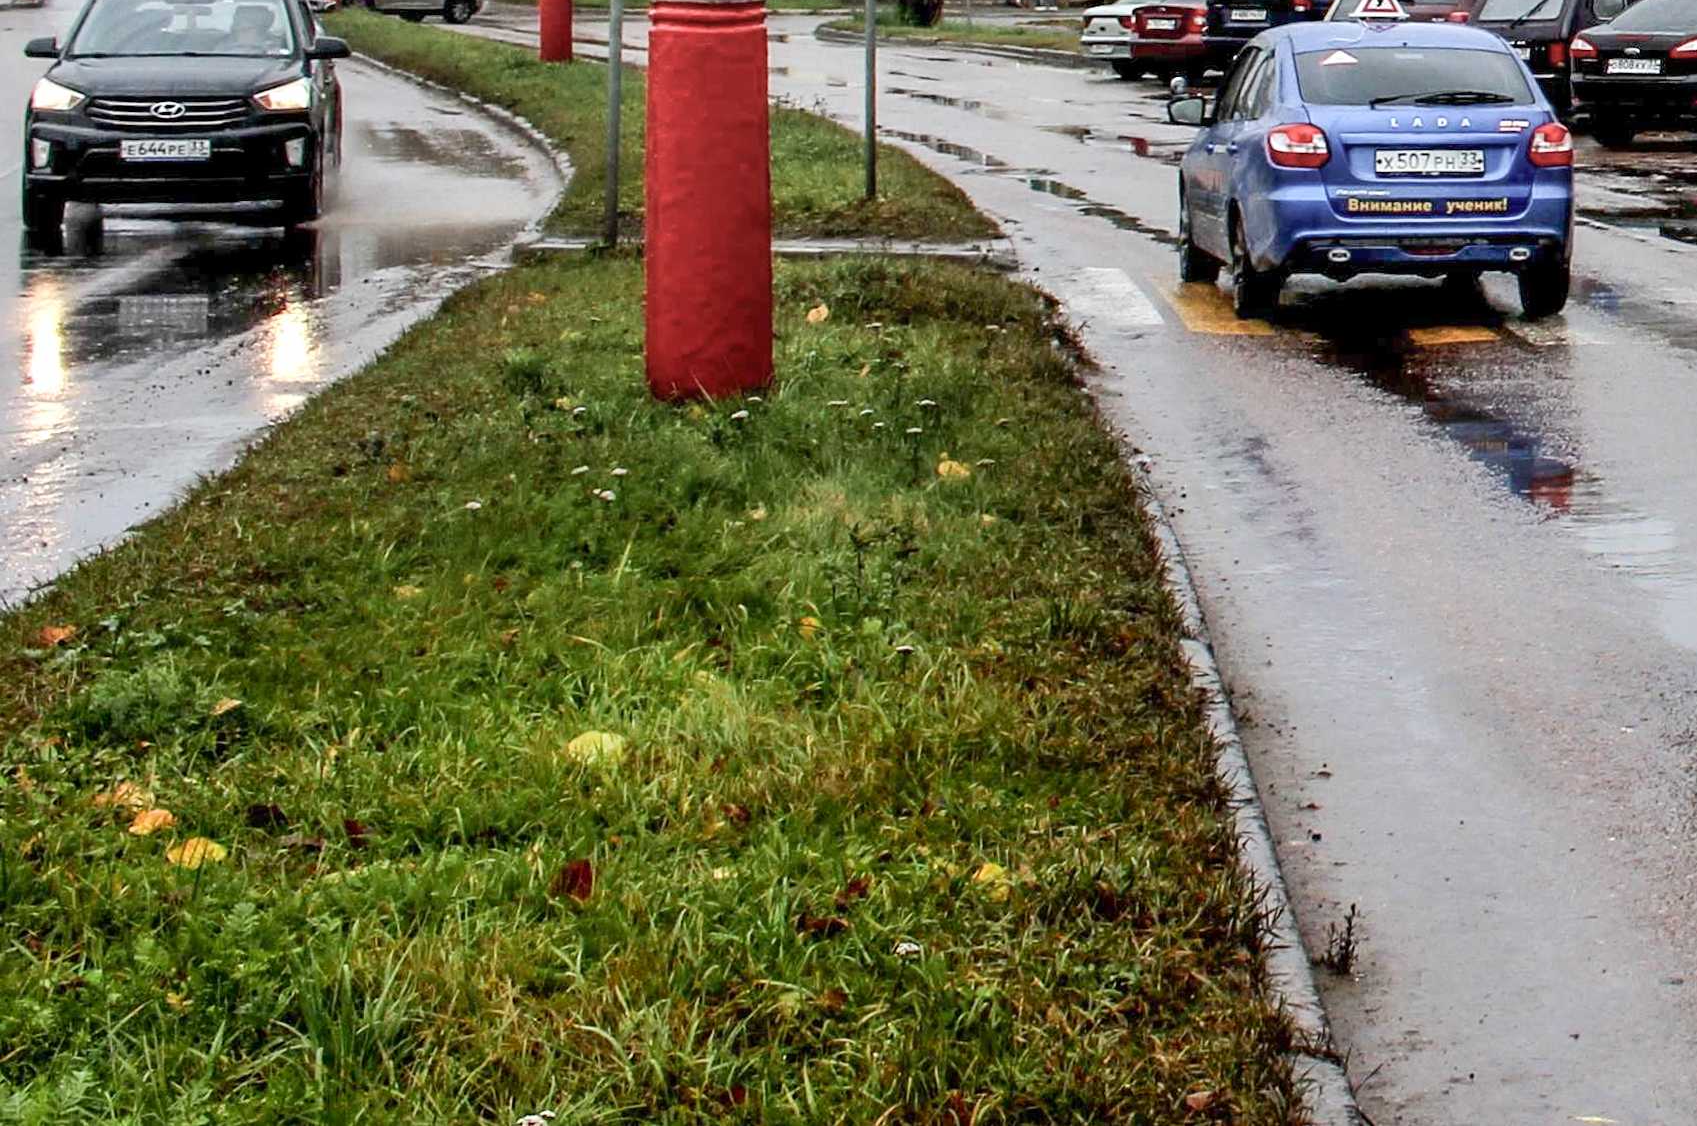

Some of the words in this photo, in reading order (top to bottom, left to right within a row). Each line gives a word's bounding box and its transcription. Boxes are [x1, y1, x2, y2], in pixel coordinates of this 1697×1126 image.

[1391, 118, 1471, 128] LADA
[1348, 198, 1433, 213] Внимание
[1446, 198, 1509, 215] ученик!
